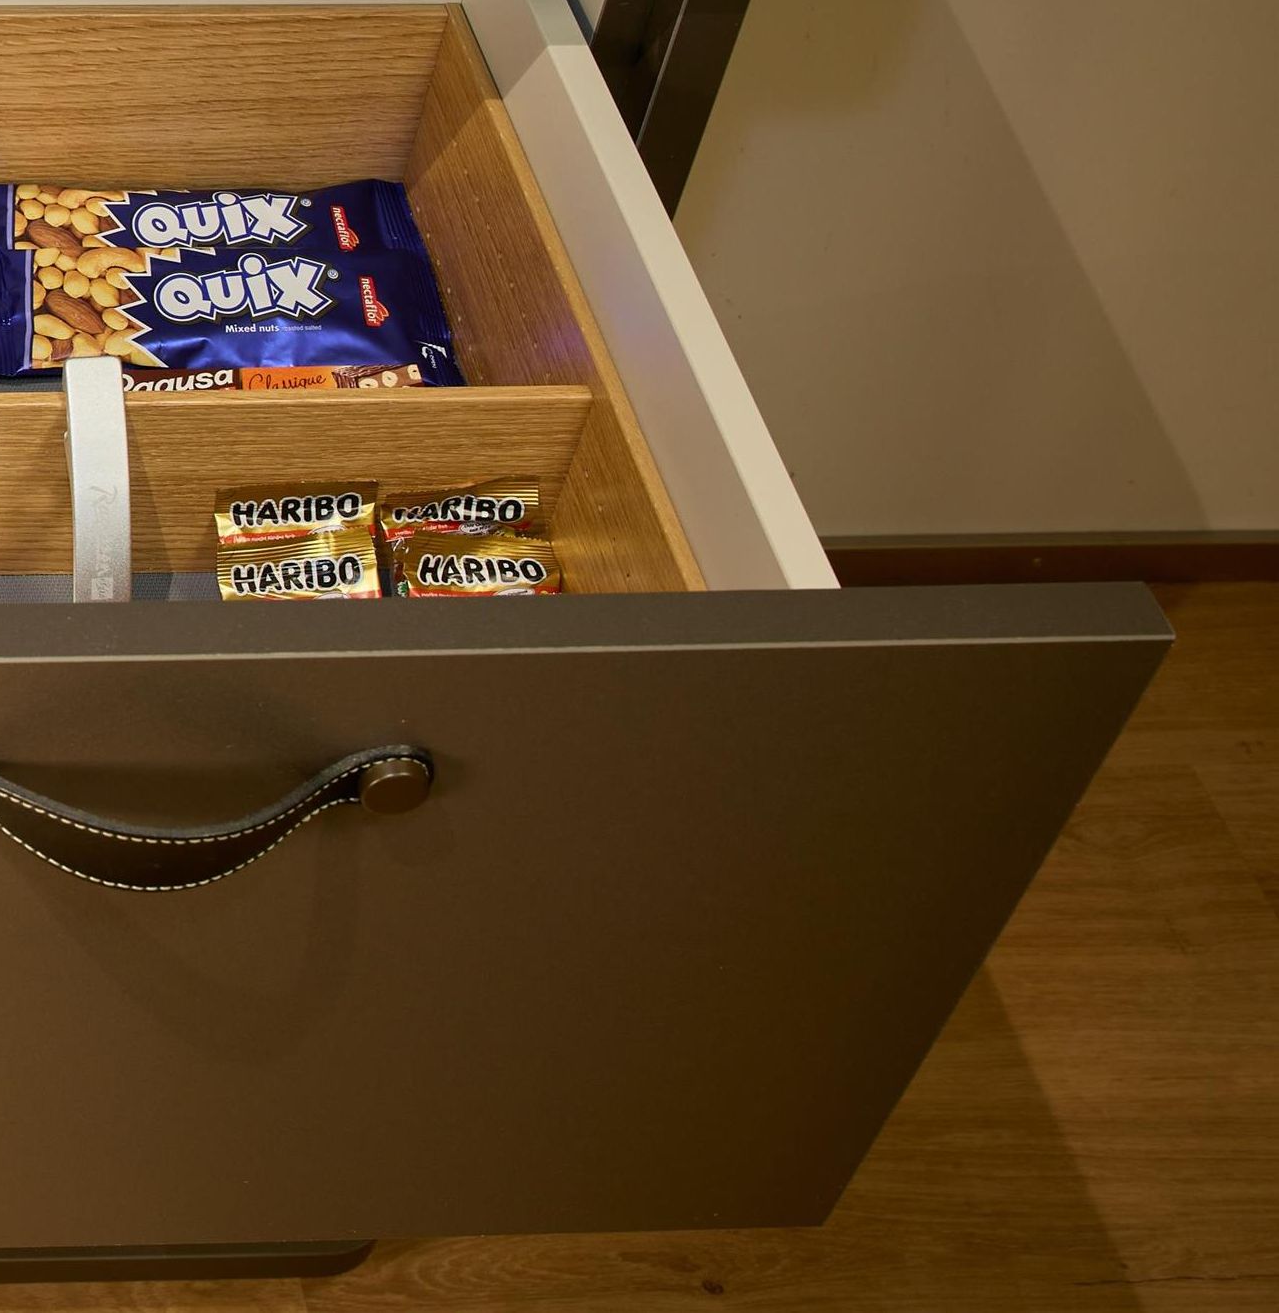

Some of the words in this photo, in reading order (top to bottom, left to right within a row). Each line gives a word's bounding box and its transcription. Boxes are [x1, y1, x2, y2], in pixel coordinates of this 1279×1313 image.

[332, 206, 350, 247] nectaflor
[360, 278, 377, 324] nectaflor
[225, 323, 257, 333] Mixed
[259, 324, 280, 332] nuts
[231, 493, 361, 526] HARIBO
[394, 495, 523, 522] HARIBO
[232, 555, 362, 595] HARIBO
[418, 555, 546, 585] HARIBO
